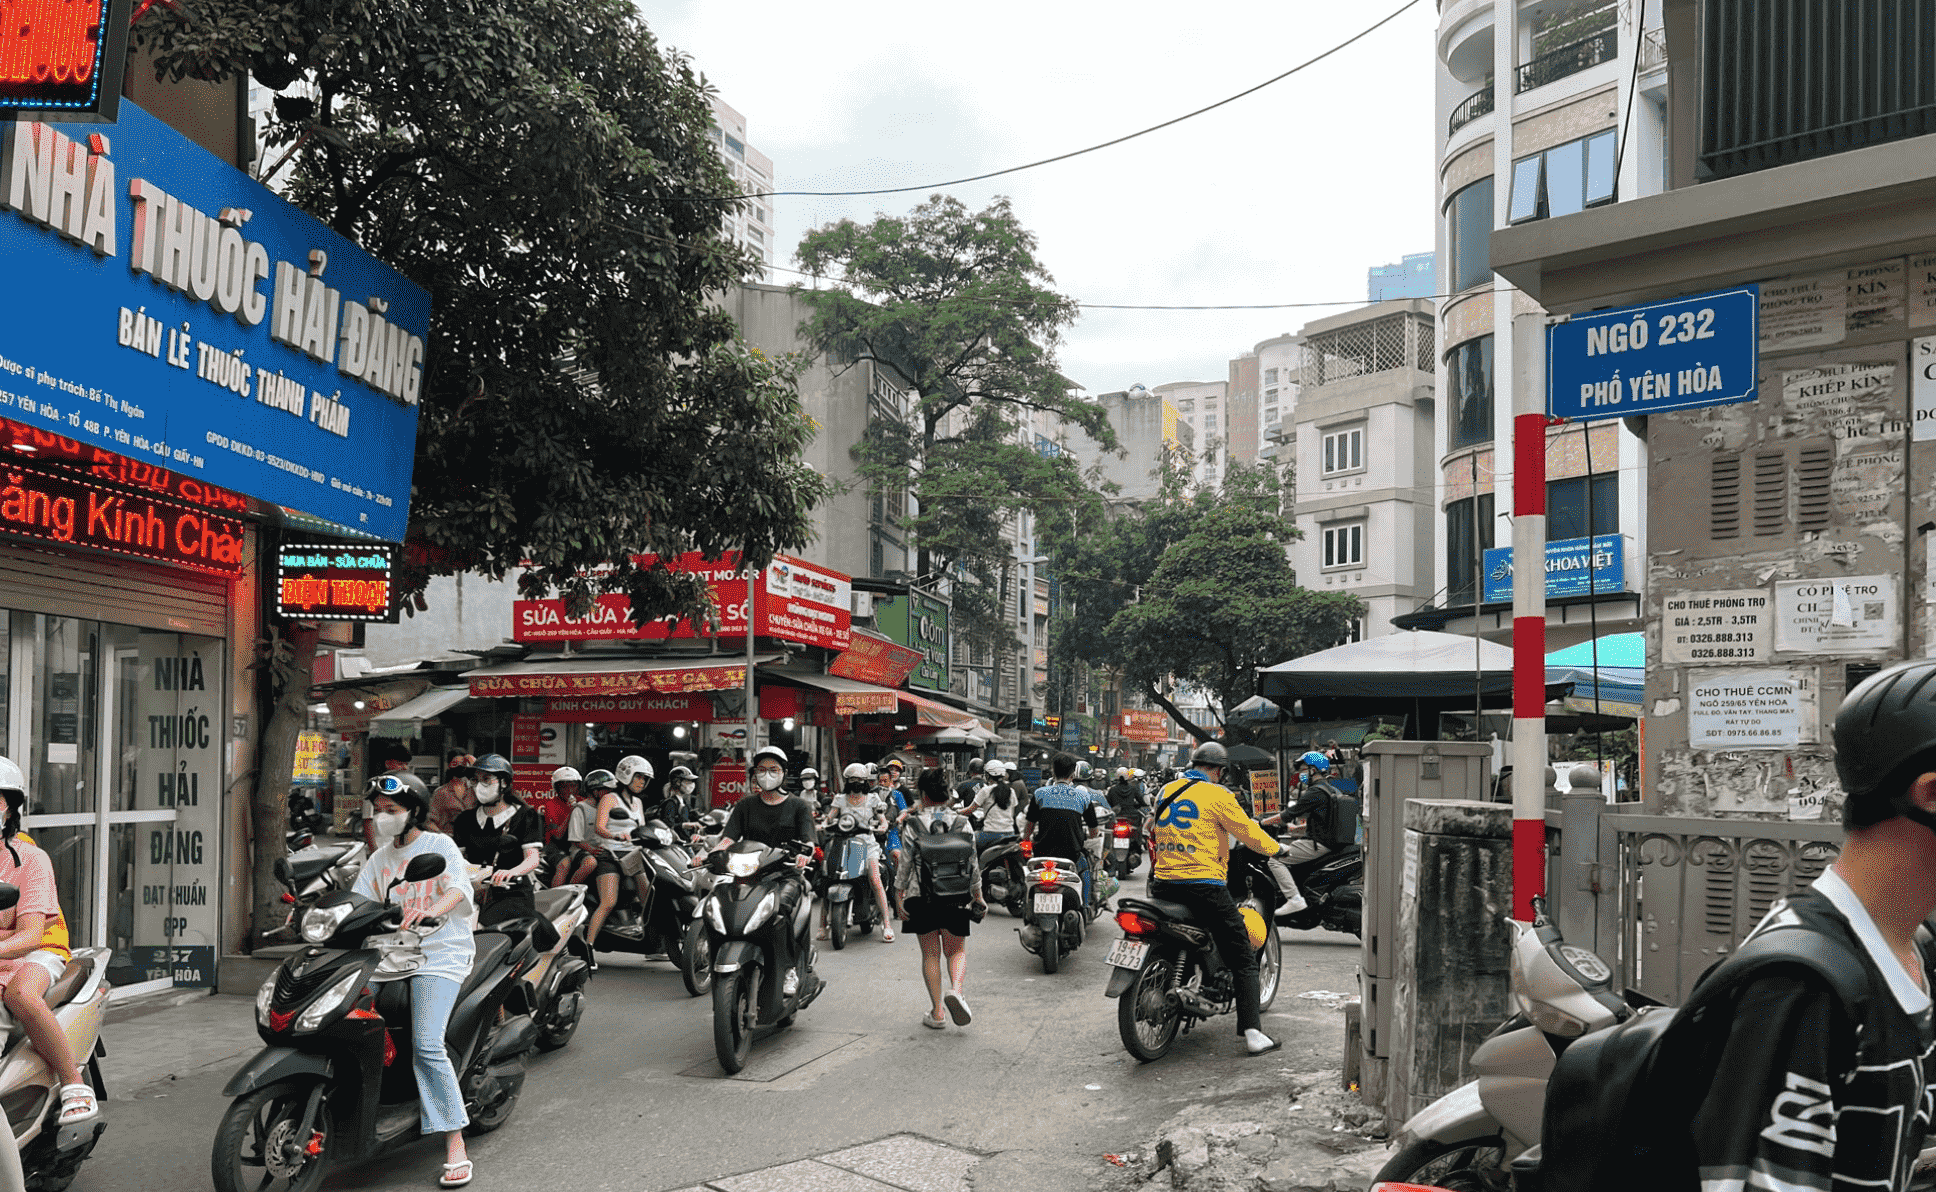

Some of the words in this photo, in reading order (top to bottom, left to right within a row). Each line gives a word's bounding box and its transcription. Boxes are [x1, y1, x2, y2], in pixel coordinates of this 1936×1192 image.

[10, 119, 116, 257] NHÀ
[130, 178, 269, 326] THUỐC
[271, 249, 341, 364] HẢI
[338, 297, 424, 406] ĐĂNG
[1586, 313, 1648, 357] NGÕ
[1658, 308, 1715, 346] 232
[119, 306, 162, 358] BÁN
[167, 322, 191, 369] LẺ
[197, 341, 251, 398] THUỐC
[256, 368, 305, 417] THÀNH
[309, 390, 350, 438] PHẨM
[1580, 369, 1623, 408] PHỐ
[1629, 370, 1671, 402] YÊN
[1677, 362, 1723, 396] HÒA
[17, 395, 36, 413] YÊN
[40, 403, 60, 421] HÒA
[114, 429, 130, 444] YÊN
[88, 491, 165, 550] Kính
[522, 603, 560, 626] SỬA
[1667, 600, 1686, 610] CHO
[1688, 597, 1710, 610] THUÊ
[1713, 597, 1745, 608] PHÒNG
[1747, 597, 1766, 609] TRỌ
[1675, 615, 1690, 627] GIÁ
[1690, 632, 1753, 643] 0326.888.313
[1691, 648, 1755, 658] 0326.888.313
[154, 651, 205, 691] NHÀ
[1695, 688, 1720, 697] CHO
[1723, 685, 1754, 697] THUÊ
[1757, 686, 1792, 696] CCMN
[1699, 699, 1719, 707] NGÕ
[1748, 698, 1766, 706] YÊN
[149, 704, 210, 750] THUỐC
[158, 760, 199, 807] HẢI
[150, 824, 203, 865] ĐĂNG
[174, 967, 202, 983] HÒA
